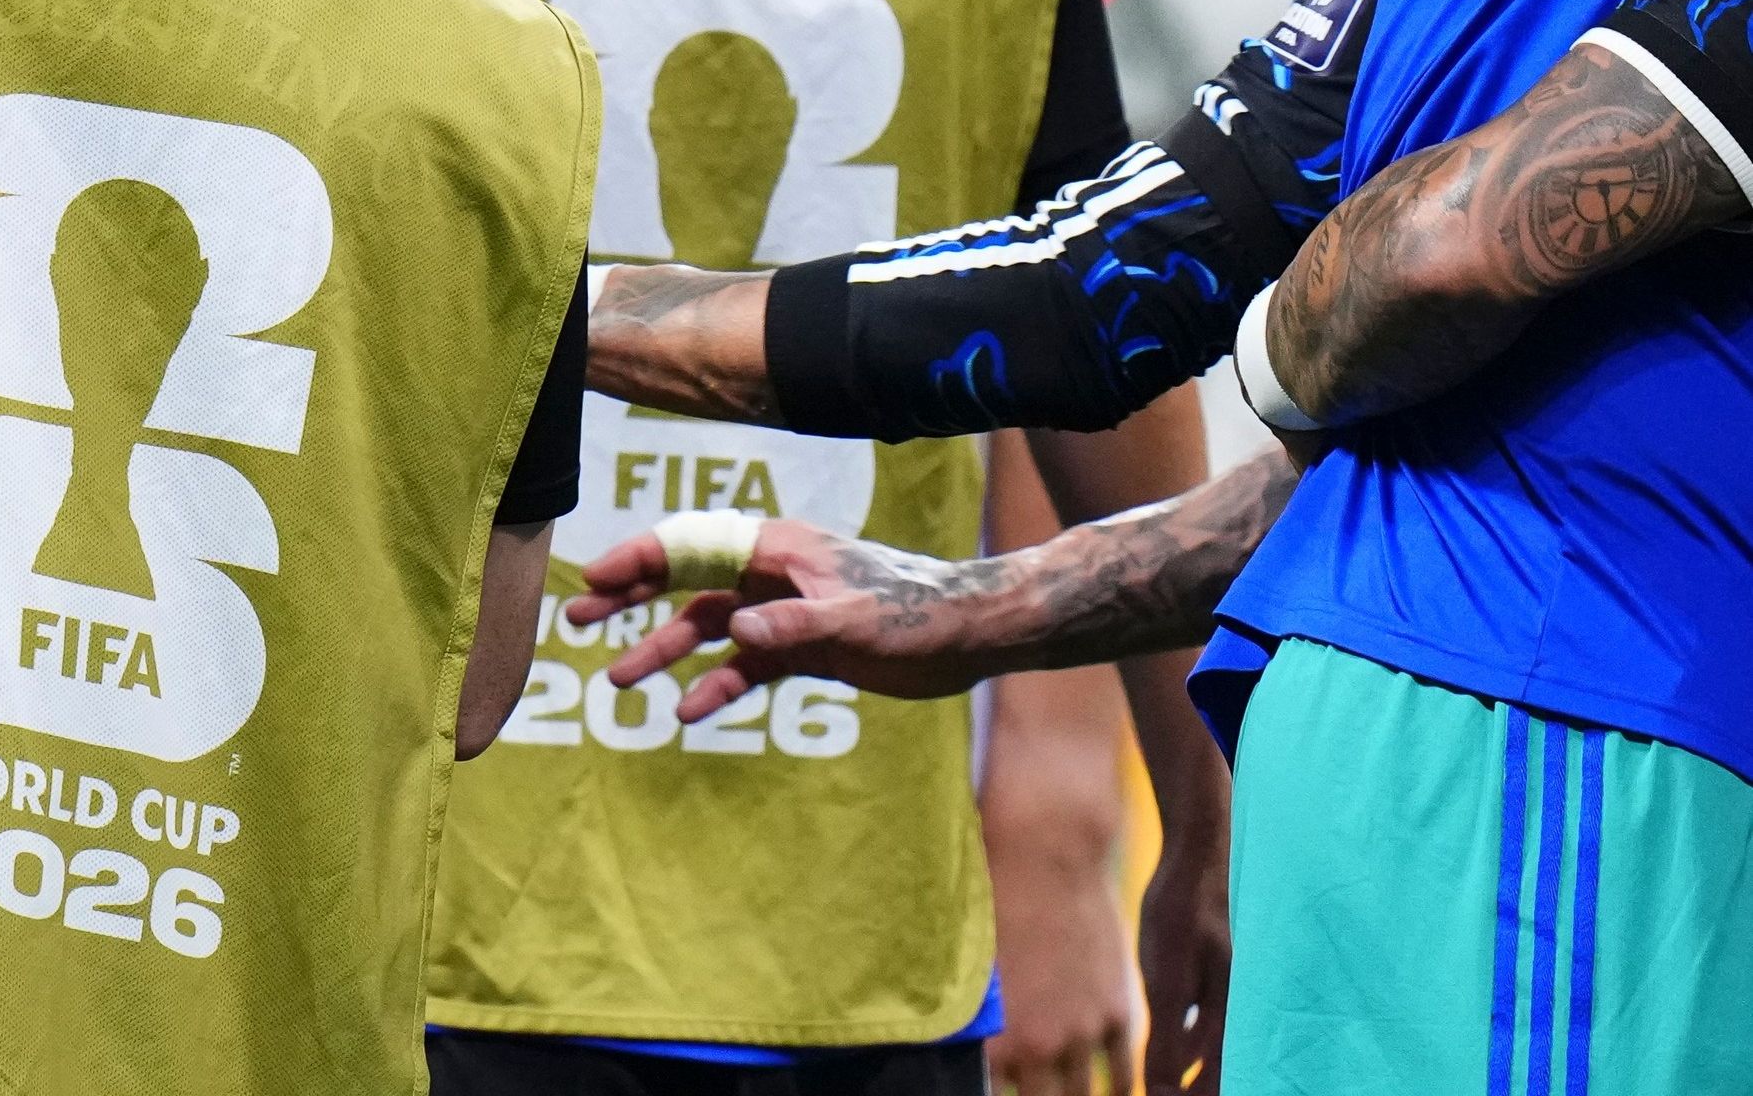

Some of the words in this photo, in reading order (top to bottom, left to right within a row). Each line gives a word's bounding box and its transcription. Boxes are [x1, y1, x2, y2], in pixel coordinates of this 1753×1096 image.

[614, 452, 783, 518] FIFA
[18, 607, 162, 699] FIFA
[497, 659, 860, 758] 2026
[131, 788, 241, 856] CUP
